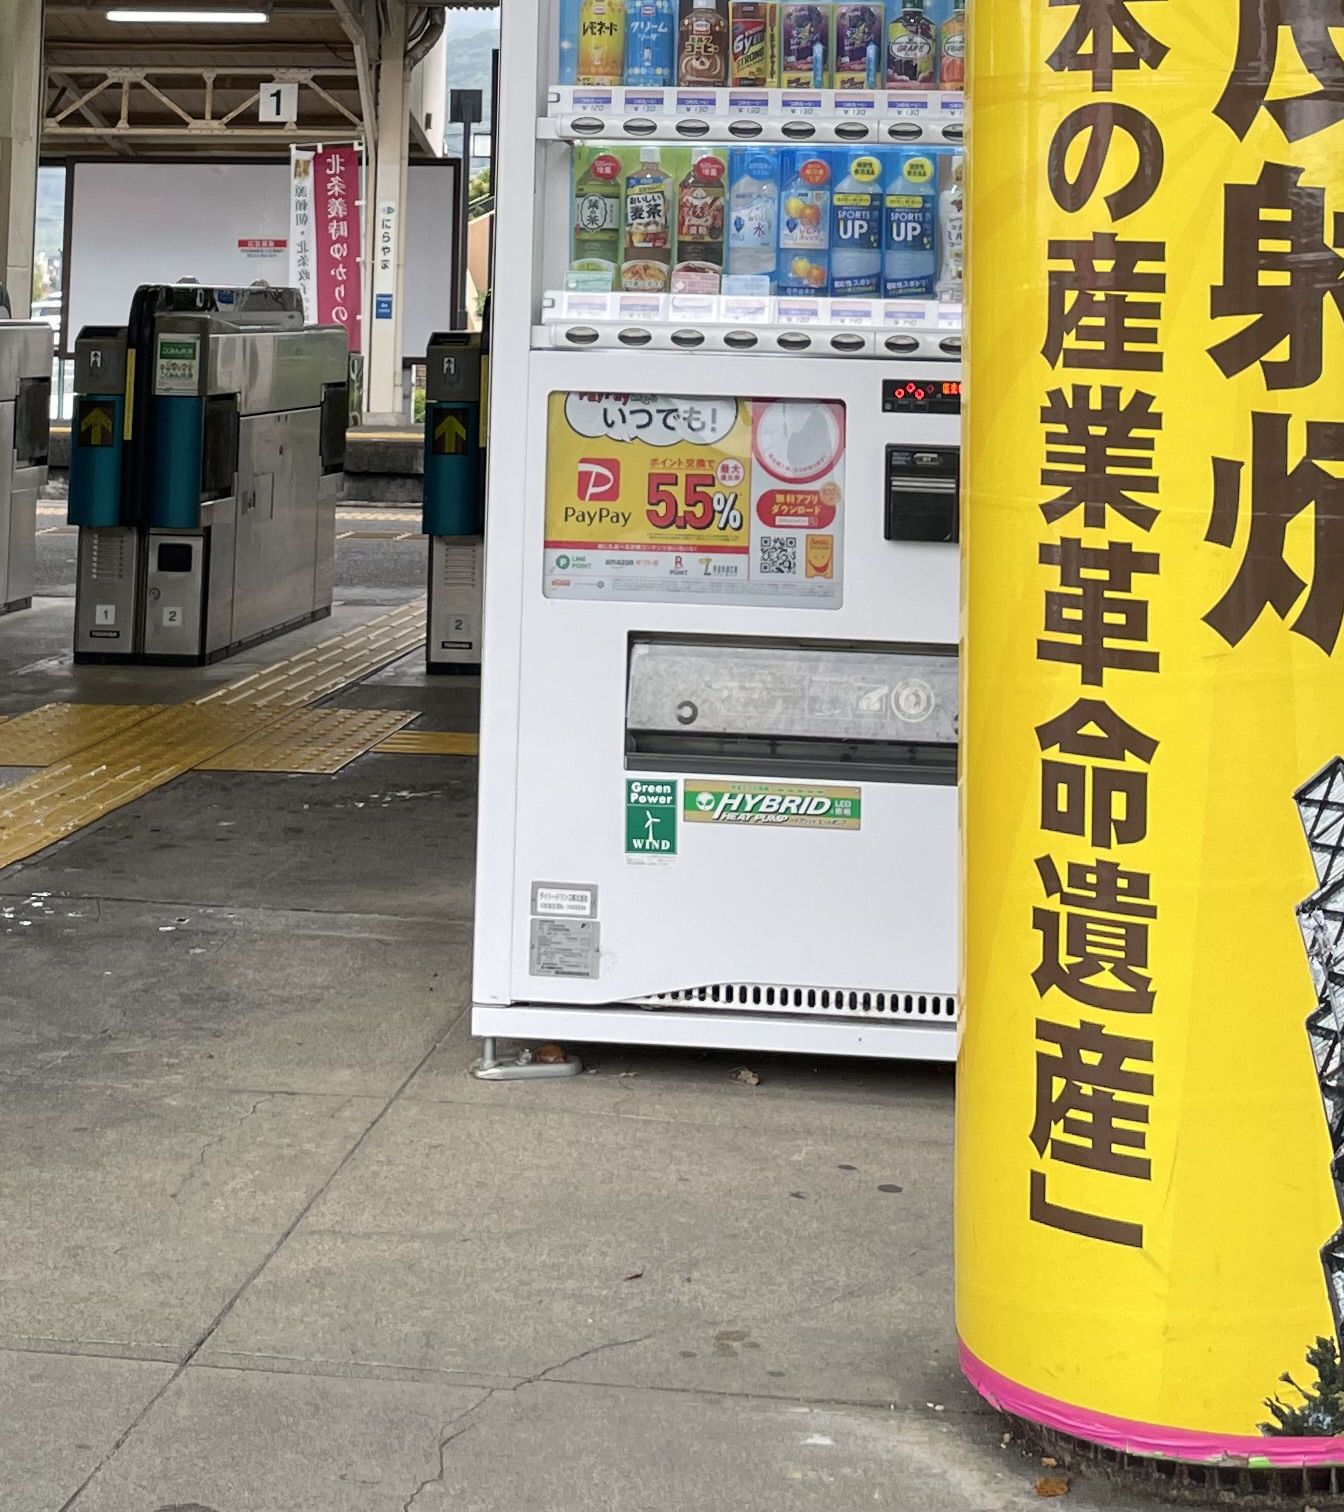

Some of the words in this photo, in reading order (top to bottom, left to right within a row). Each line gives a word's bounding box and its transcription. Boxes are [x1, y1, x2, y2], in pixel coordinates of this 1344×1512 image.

[582, 22, 618, 36] レモネード
[269, 88, 282, 117] 1
[629, 194, 662, 205] おいしい
[630, 203, 662, 221] 麦茶
[837, 209, 871, 220] SPORTS
[890, 212, 923, 222] SPORTS
[839, 219, 868, 239] UP
[892, 221, 921, 242] UP
[602, 407, 718, 433] いつでも!
[649, 457, 716, 470] ポイント交換で
[646, 472, 744, 532] 5.5%
[775, 493, 819, 505] 無料アプリ
[771, 504, 822, 516] ダウンロード
[564, 506, 633, 528] PayPay
[630, 781, 672, 794] Green
[630, 793, 673, 805] Power
[712, 792, 833, 821] HYBRID
[719, 812, 752, 822] HEAT
[753, 813, 790, 824] PUMP
[632, 838, 671, 851] WIND
